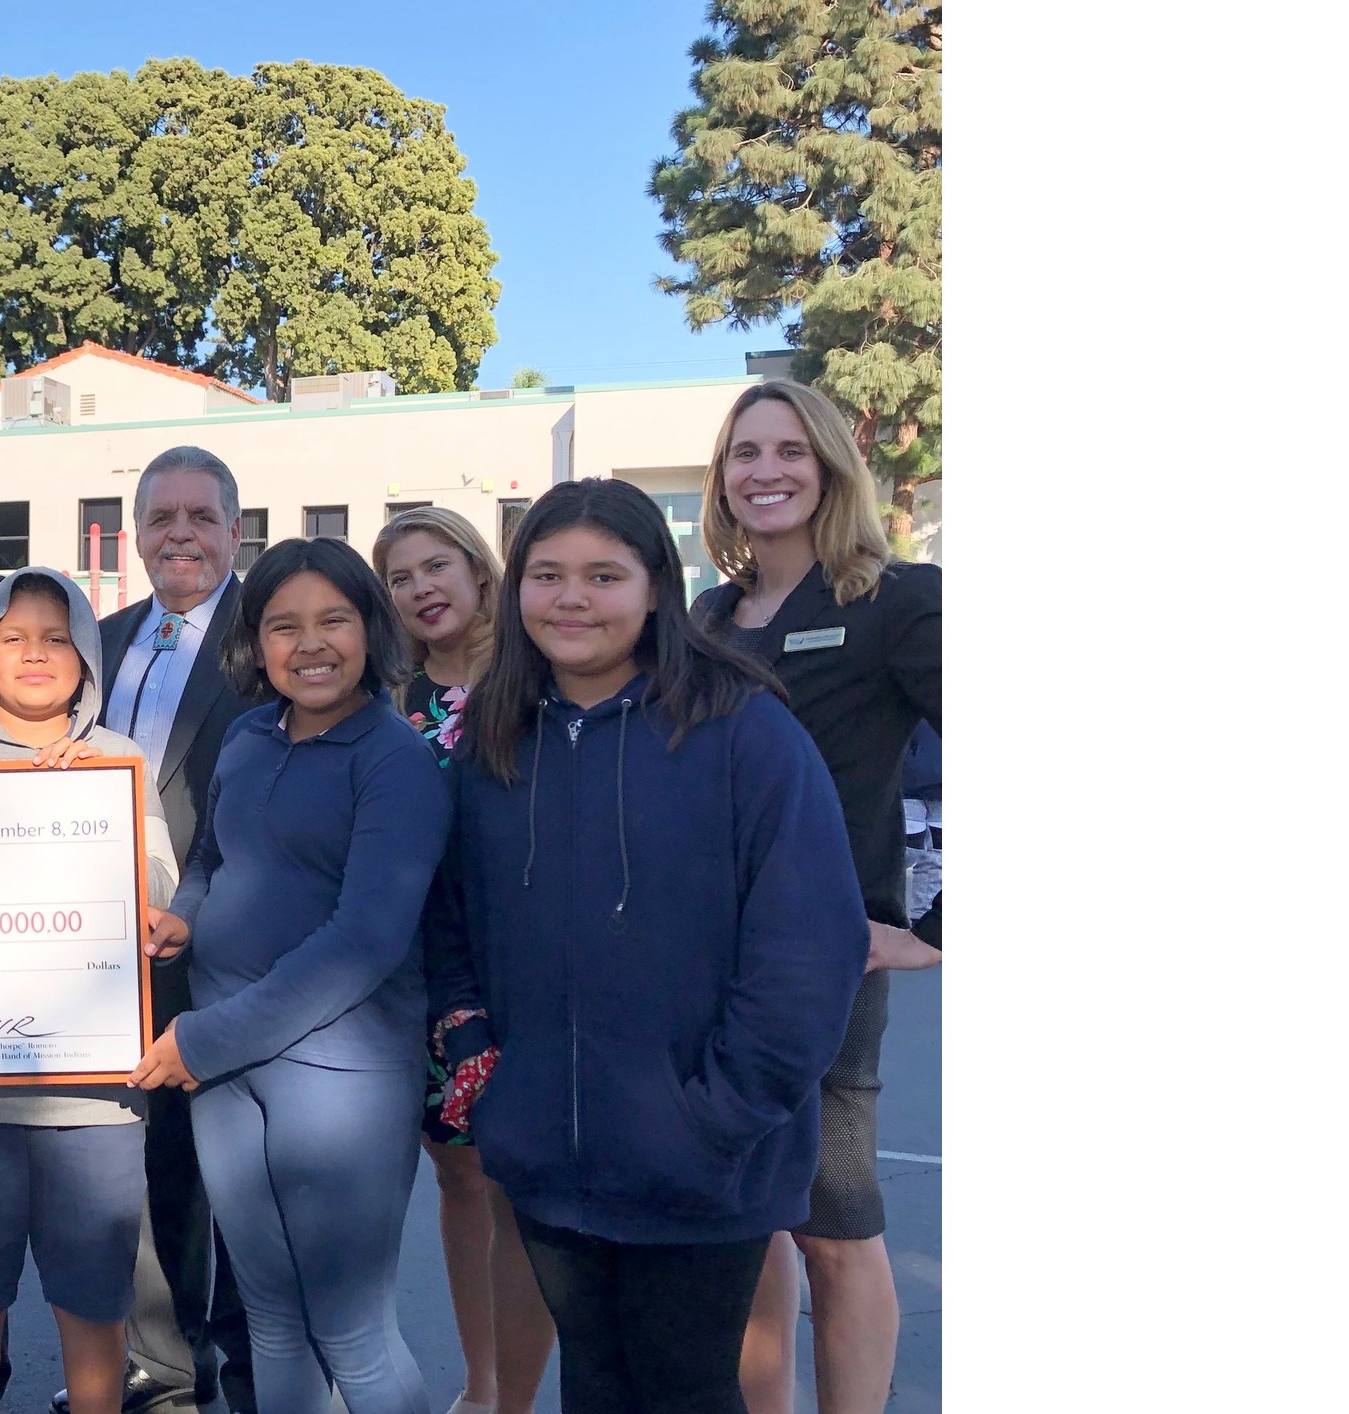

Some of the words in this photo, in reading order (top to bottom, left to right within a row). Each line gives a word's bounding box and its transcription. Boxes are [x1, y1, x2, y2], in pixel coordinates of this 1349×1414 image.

[51, 821, 66, 838] 8,
[70, 819, 109, 836] 2019
[87, 961, 121, 970] Dollars
[1, 1052, 21, 1060] Band
[22, 1051, 32, 1059] of
[33, 1050, 62, 1059] Mission
